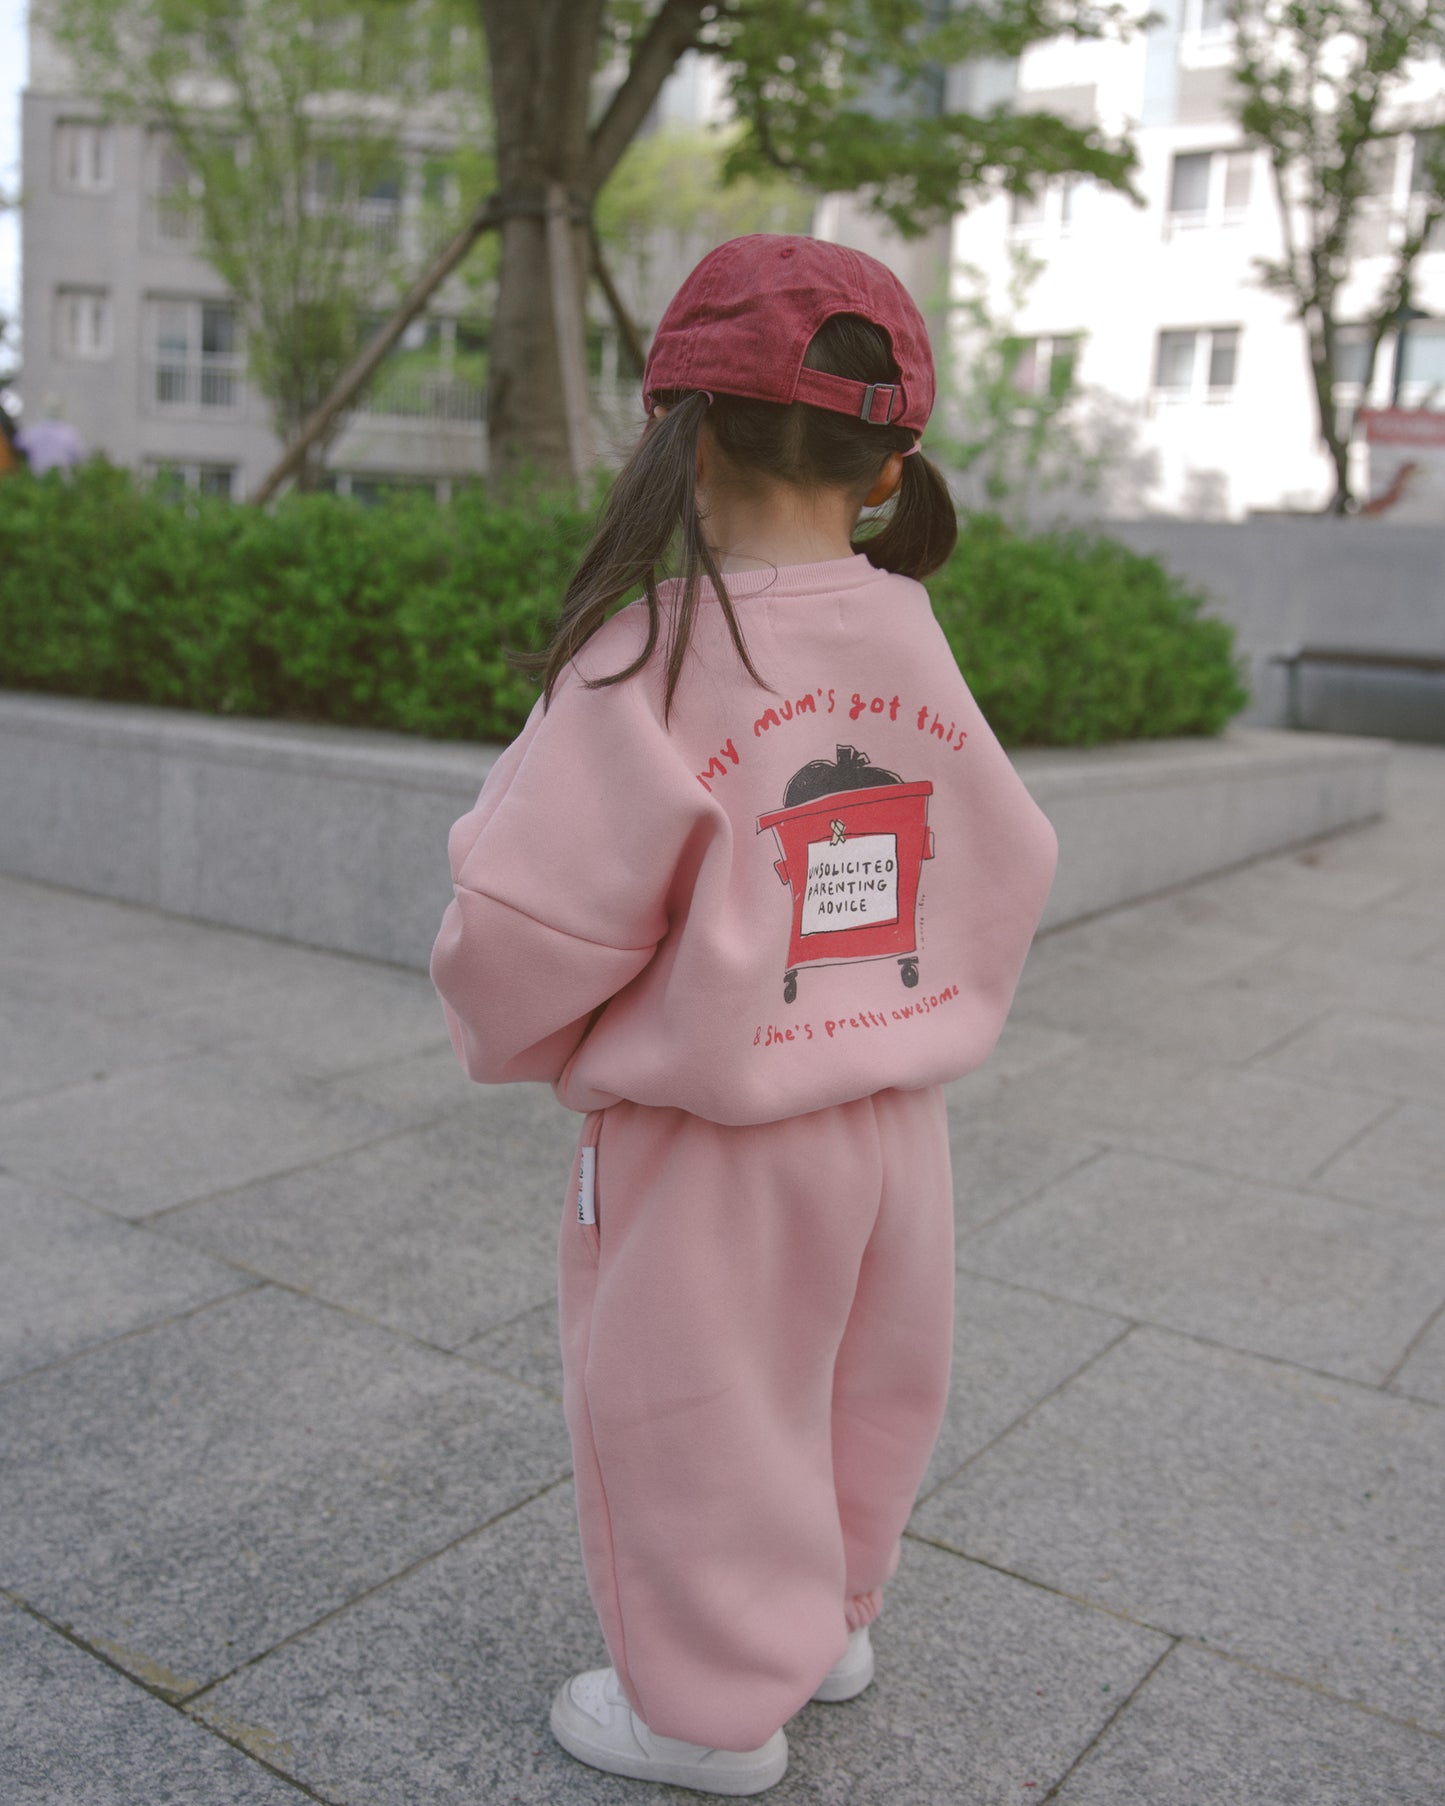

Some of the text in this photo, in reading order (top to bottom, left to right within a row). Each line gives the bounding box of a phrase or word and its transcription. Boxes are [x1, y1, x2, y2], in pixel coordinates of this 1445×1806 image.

[849, 693, 901, 722] got
[916, 705, 968, 751] this
[808, 859, 894, 880] UNSOLICITED
[807, 879, 888, 902] PARENTING
[817, 898, 867, 915] ADVICE
[824, 1011, 888, 1038] pretty
[891, 984, 960, 1021] awesome
